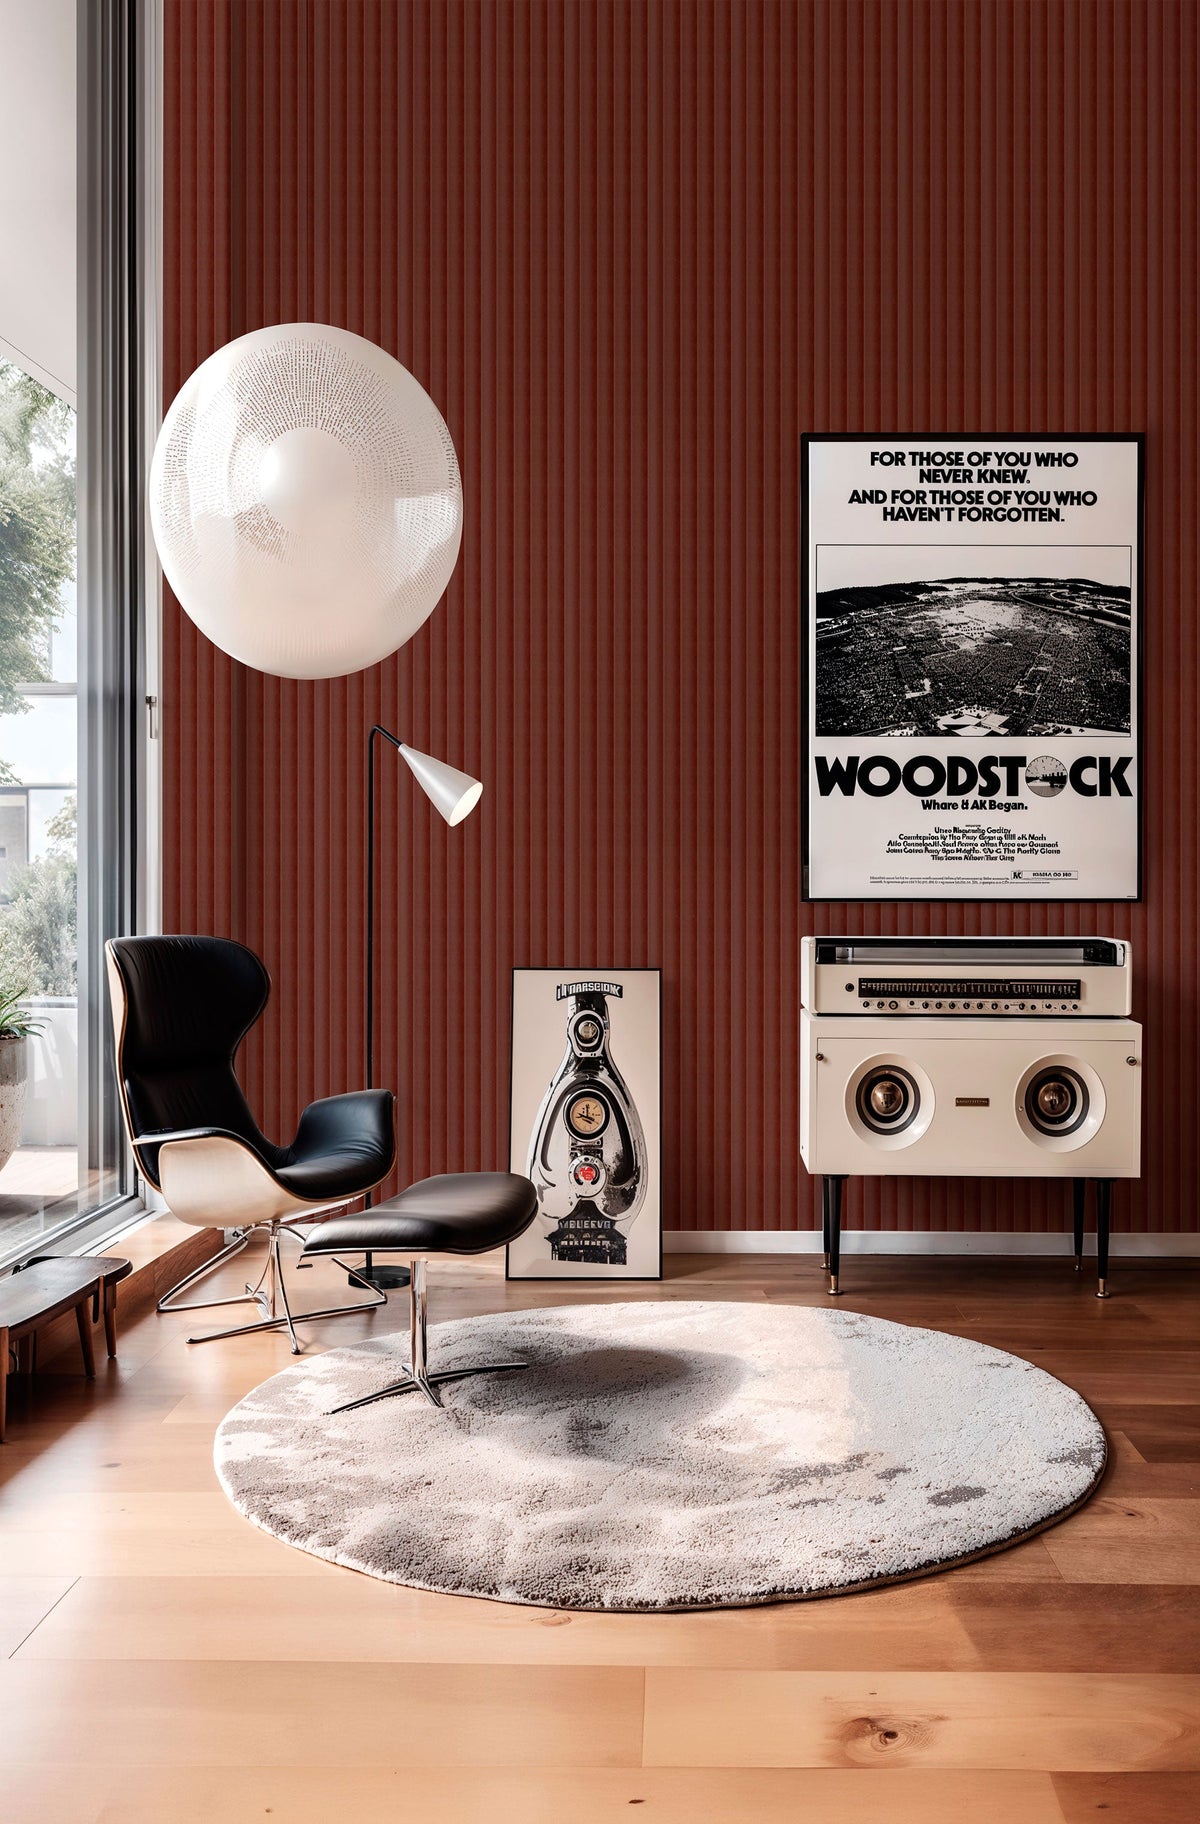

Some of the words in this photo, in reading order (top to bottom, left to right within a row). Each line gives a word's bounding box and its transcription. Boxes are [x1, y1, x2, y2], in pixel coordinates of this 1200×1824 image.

[870, 451, 907, 467] FOR
[908, 451, 965, 467] THOSE
[966, 451, 993, 467] OF
[993, 451, 1032, 467] YOU
[1033, 451, 1079, 468] WHO
[919, 468, 974, 484] NEVER
[976, 468, 1031, 484] KNEW.
[847, 489, 888, 505] AND
[890, 489, 928, 505] FOR
[928, 489, 985, 506] THOSE
[986, 489, 1013, 506] OF
[1013, 490, 1051, 506] YOU
[1053, 490, 1098, 507] WHO
[882, 506, 956, 522] HAVEN'T
[958, 506, 1066, 523] FORGOTTEN.
[814, 755, 1134, 798] WOODSTOCK
[988, 799, 1029, 813] Began.
